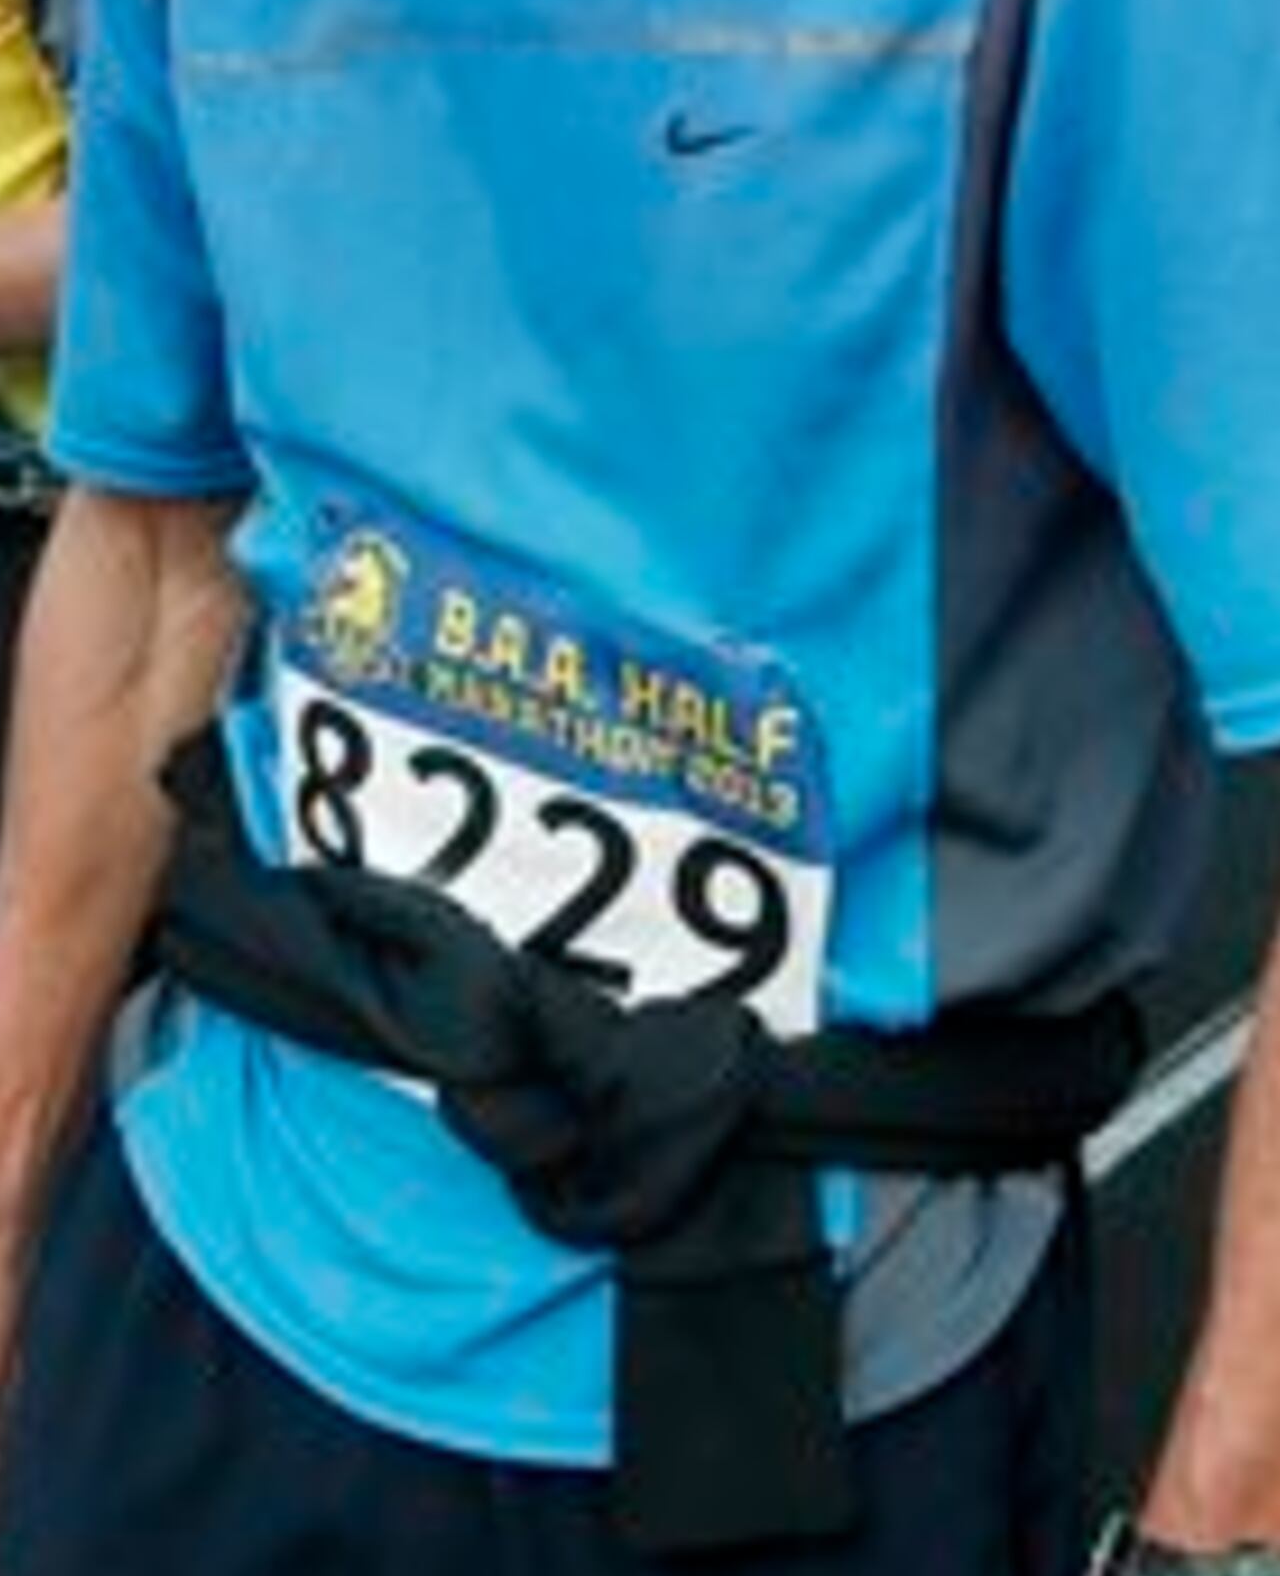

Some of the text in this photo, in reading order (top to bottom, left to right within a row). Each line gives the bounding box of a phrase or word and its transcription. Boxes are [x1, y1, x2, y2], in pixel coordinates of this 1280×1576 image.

[426, 659, 677, 779] MARATHON
[432, 588, 800, 771] B.A.A. HALF
[298, 697, 790, 1003] 8229
